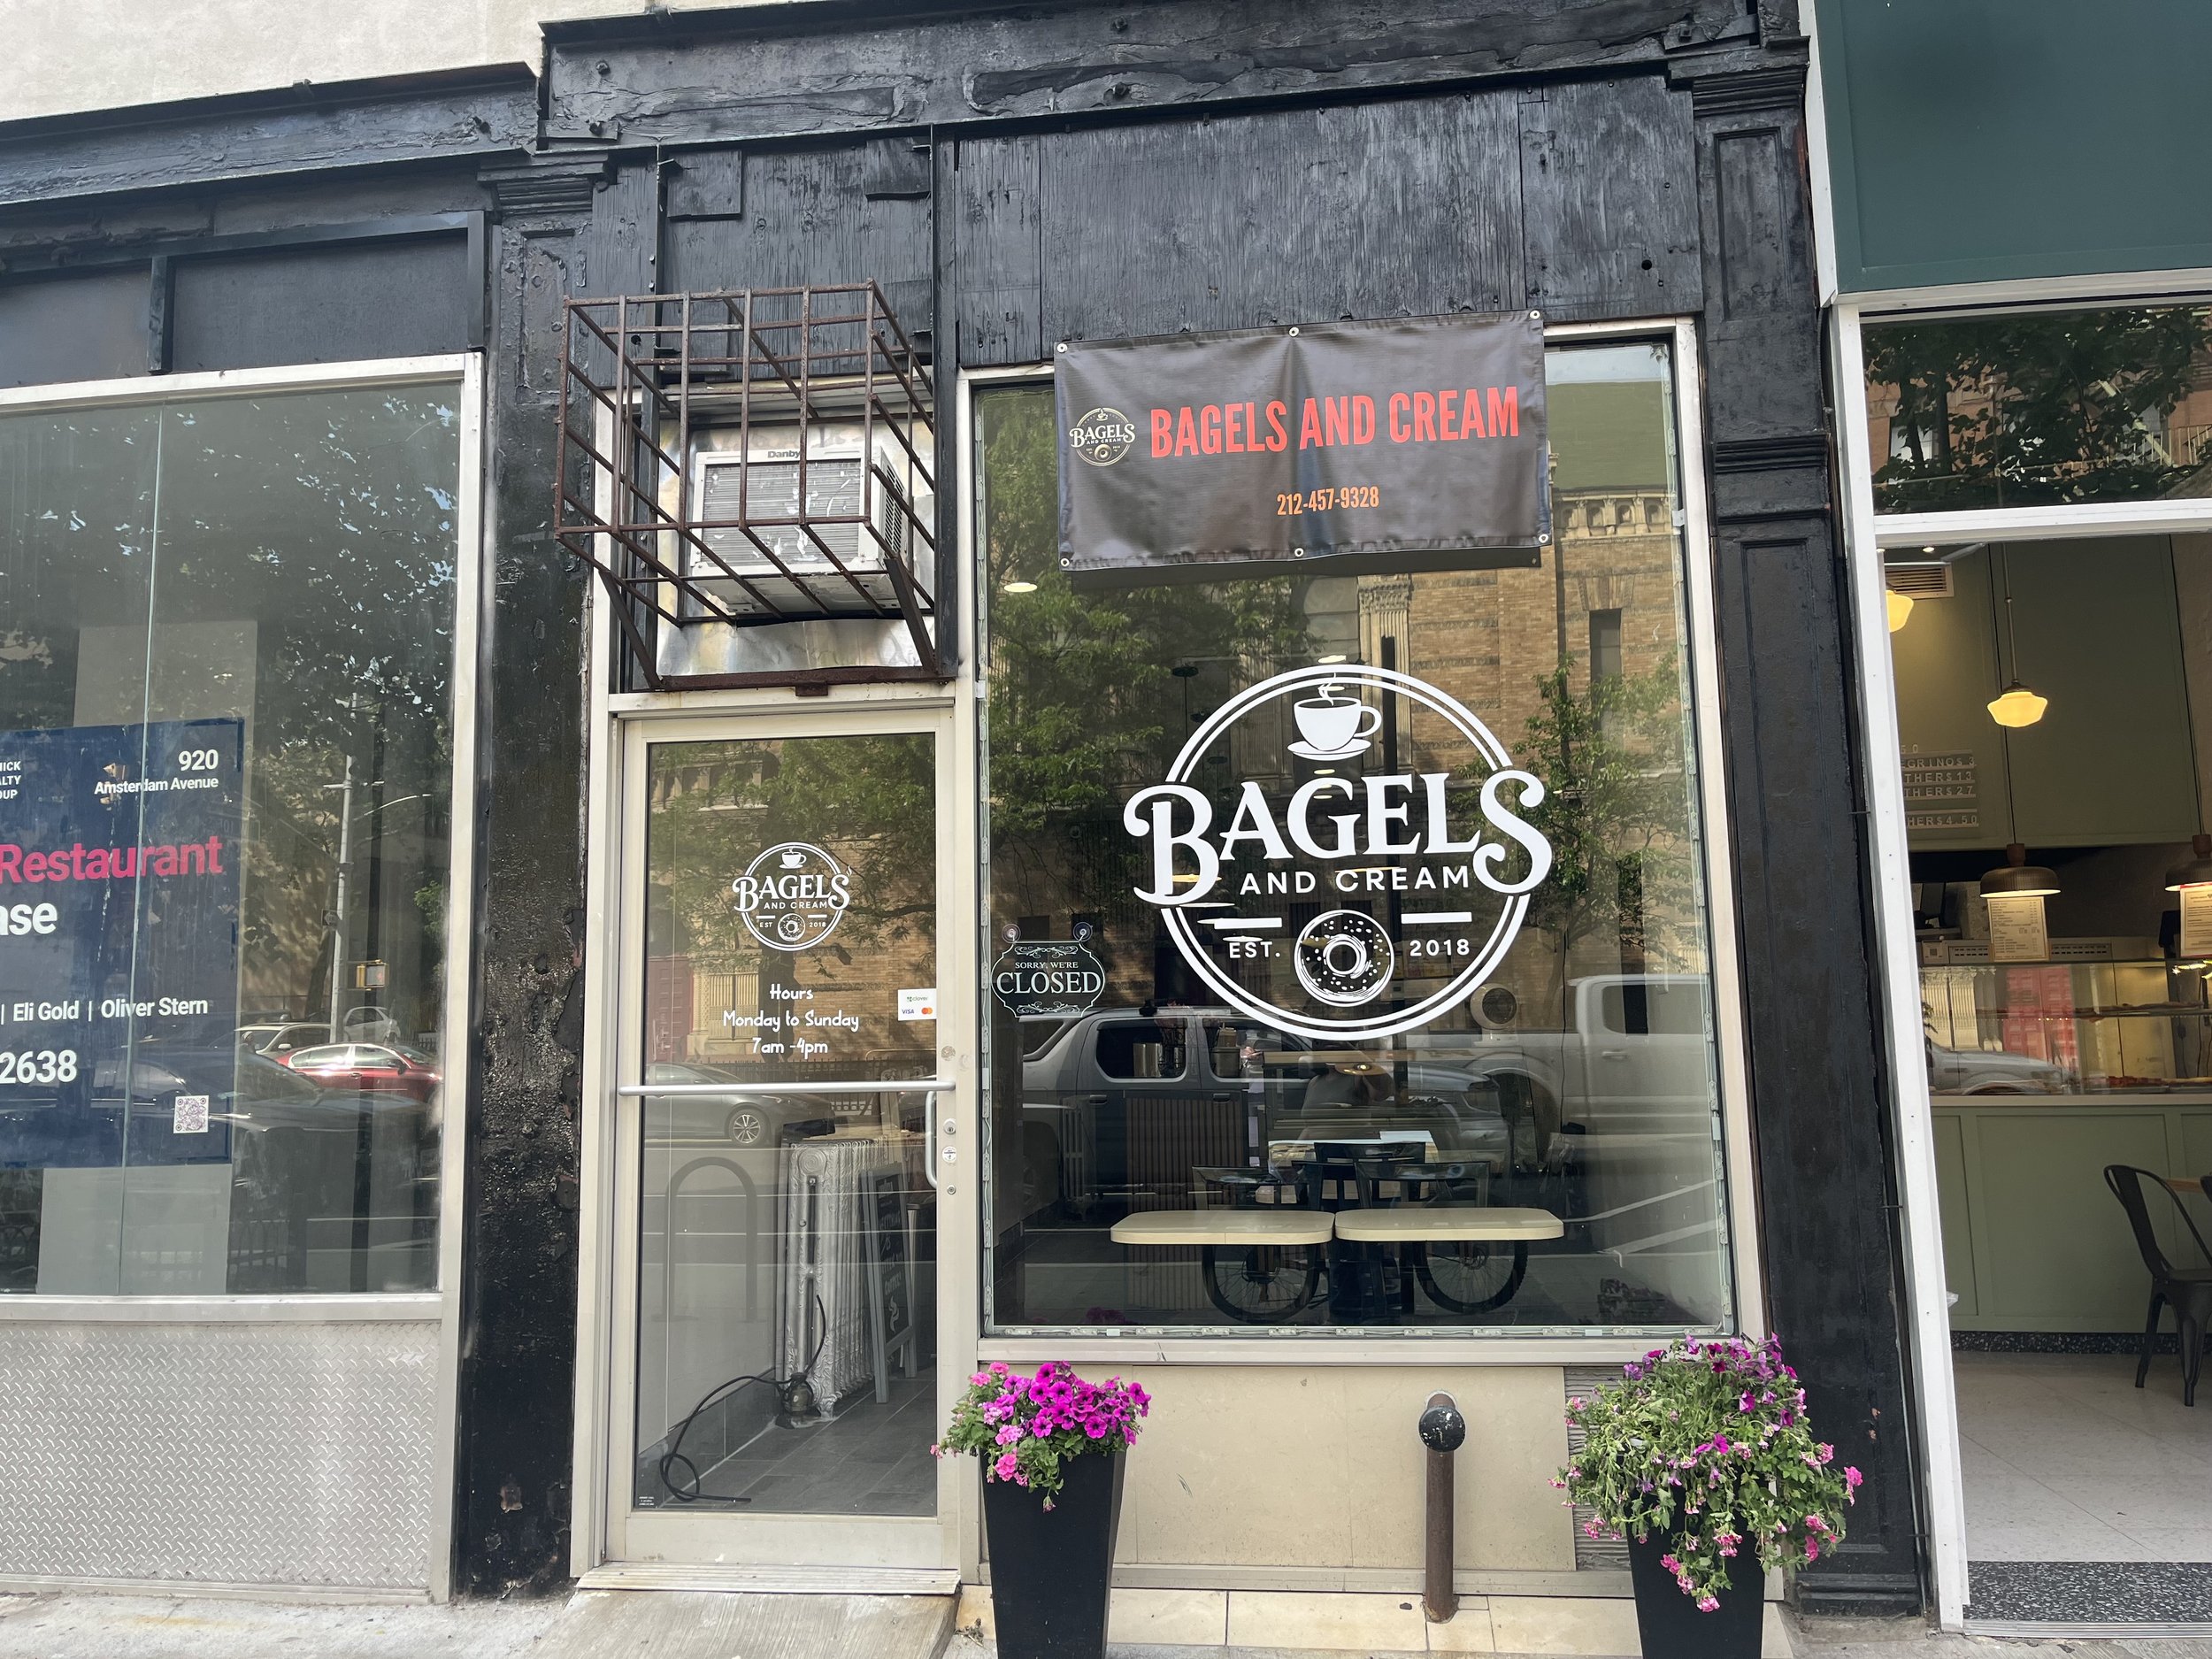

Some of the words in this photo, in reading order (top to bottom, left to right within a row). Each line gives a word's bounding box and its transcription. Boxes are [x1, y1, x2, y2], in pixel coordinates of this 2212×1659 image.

[1150, 400, 1288, 458] BAGELS
[1299, 395, 1376, 449] AND
[1389, 386, 1518, 442] CREAM
[1069, 423, 1136, 448] BAGELS
[767, 449, 801, 458] Danby
[1277, 486, 1379, 516] 212-457-9328
[0, 761, 21, 772] ICK
[178, 749, 219, 772] 920
[0, 775, 21, 786] LTY
[94, 779, 168, 795] Amsterdam
[170, 777, 219, 790] Avenue
[1123, 769, 1553, 906] BAGELS
[0, 835, 224, 883] Restaurant
[1240, 871, 1317, 895] AND
[1335, 865, 1469, 893] CREAM
[732, 872, 850, 912] BAGELS
[790, 901, 827, 910] CREAM
[1228, 941, 1281, 958] EST.
[1410, 939, 1470, 956] 2018
[770, 984, 814, 1000] Hours
[996, 972, 1102, 994] CLOSED
[13, 1002, 34, 1021] Eli
[38, 1000, 80, 1020] Gold
[101, 998, 155, 1018] Oliver
[158, 997, 208, 1016] Stern
[723, 1010, 780, 1032] Monday
[786, 1010, 800, 1026] to
[805, 1010, 859, 1032] Sunday
[752, 1038, 784, 1053] 7am
[0, 1049, 77, 1084] 2638
